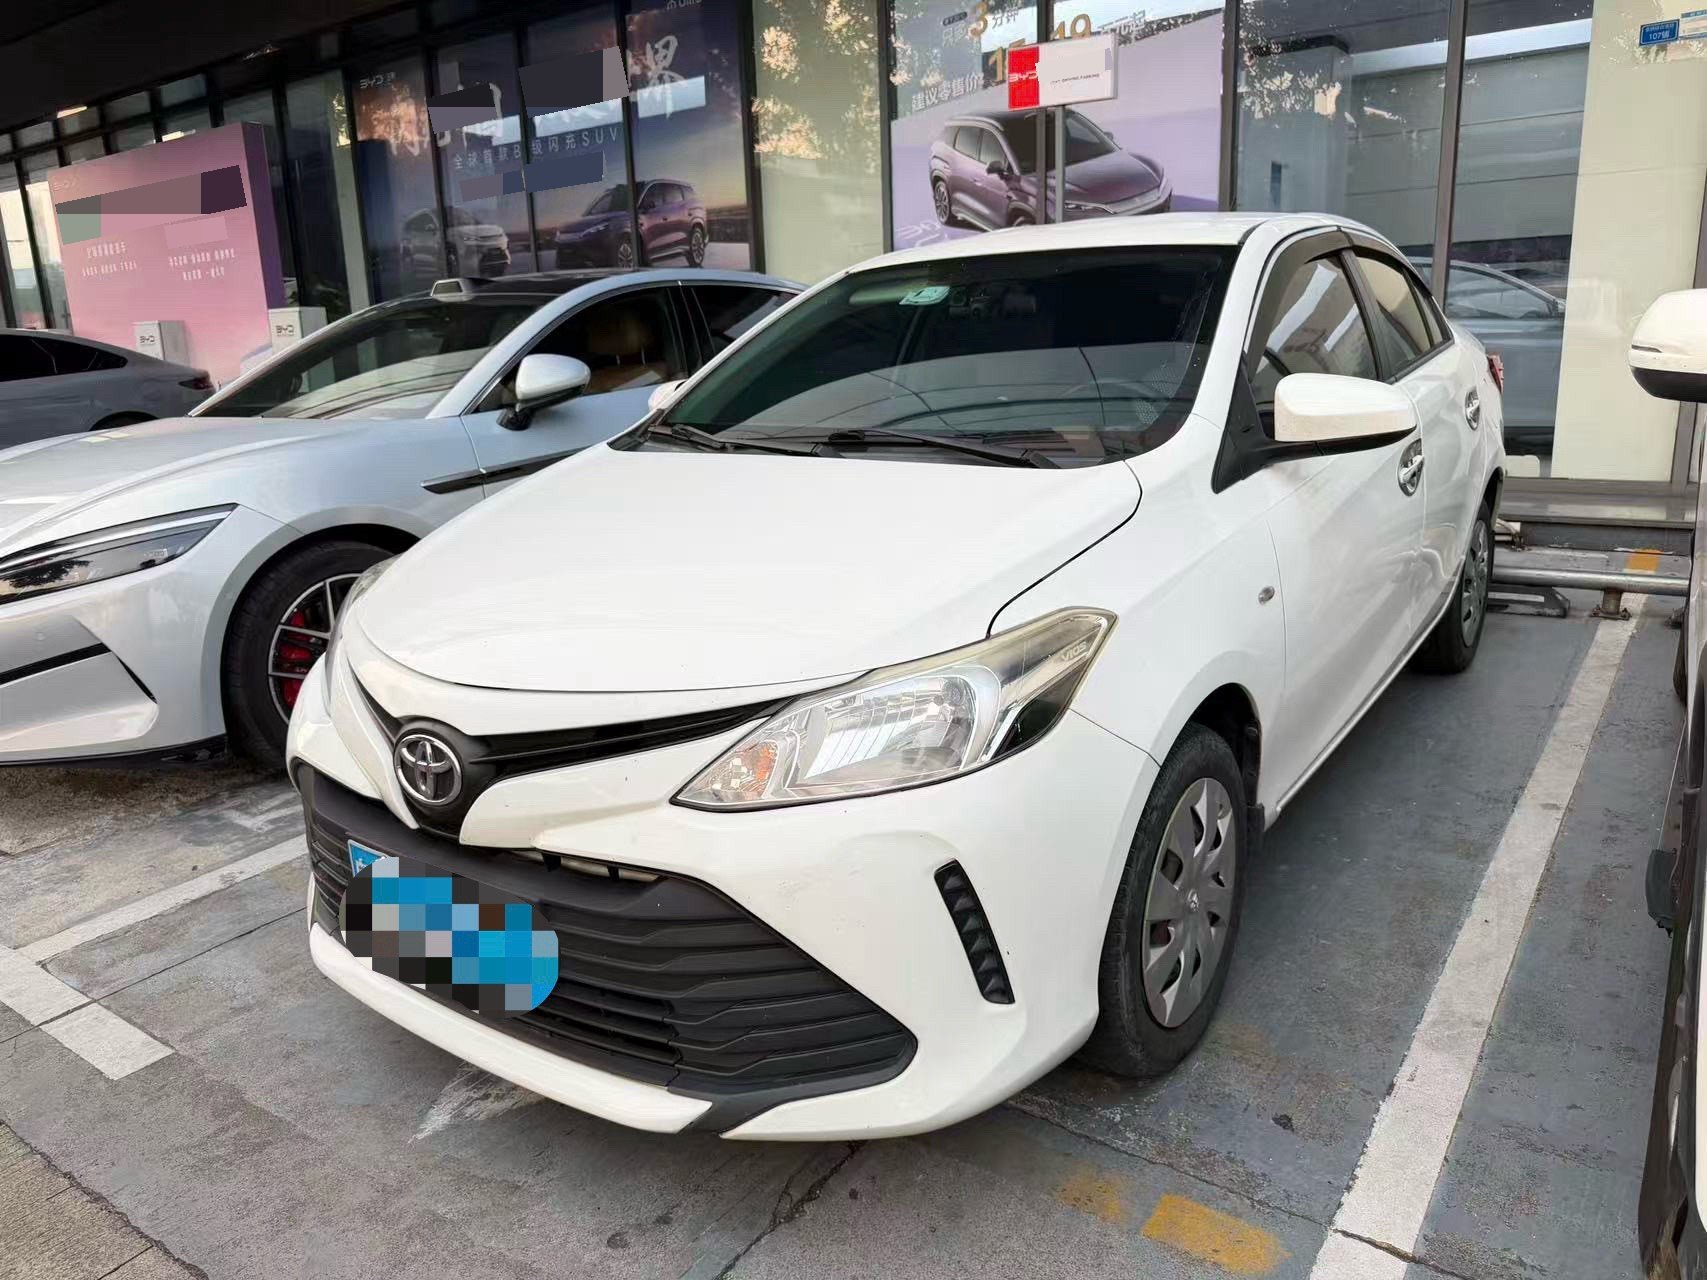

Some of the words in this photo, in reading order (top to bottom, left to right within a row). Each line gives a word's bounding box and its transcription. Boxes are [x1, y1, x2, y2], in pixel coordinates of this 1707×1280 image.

[1008, 70, 1038, 83] BYD
[275, 324, 294, 334] BYD
[139, 335, 155, 344] BYD
[1062, 641, 1087, 661] VIOS
